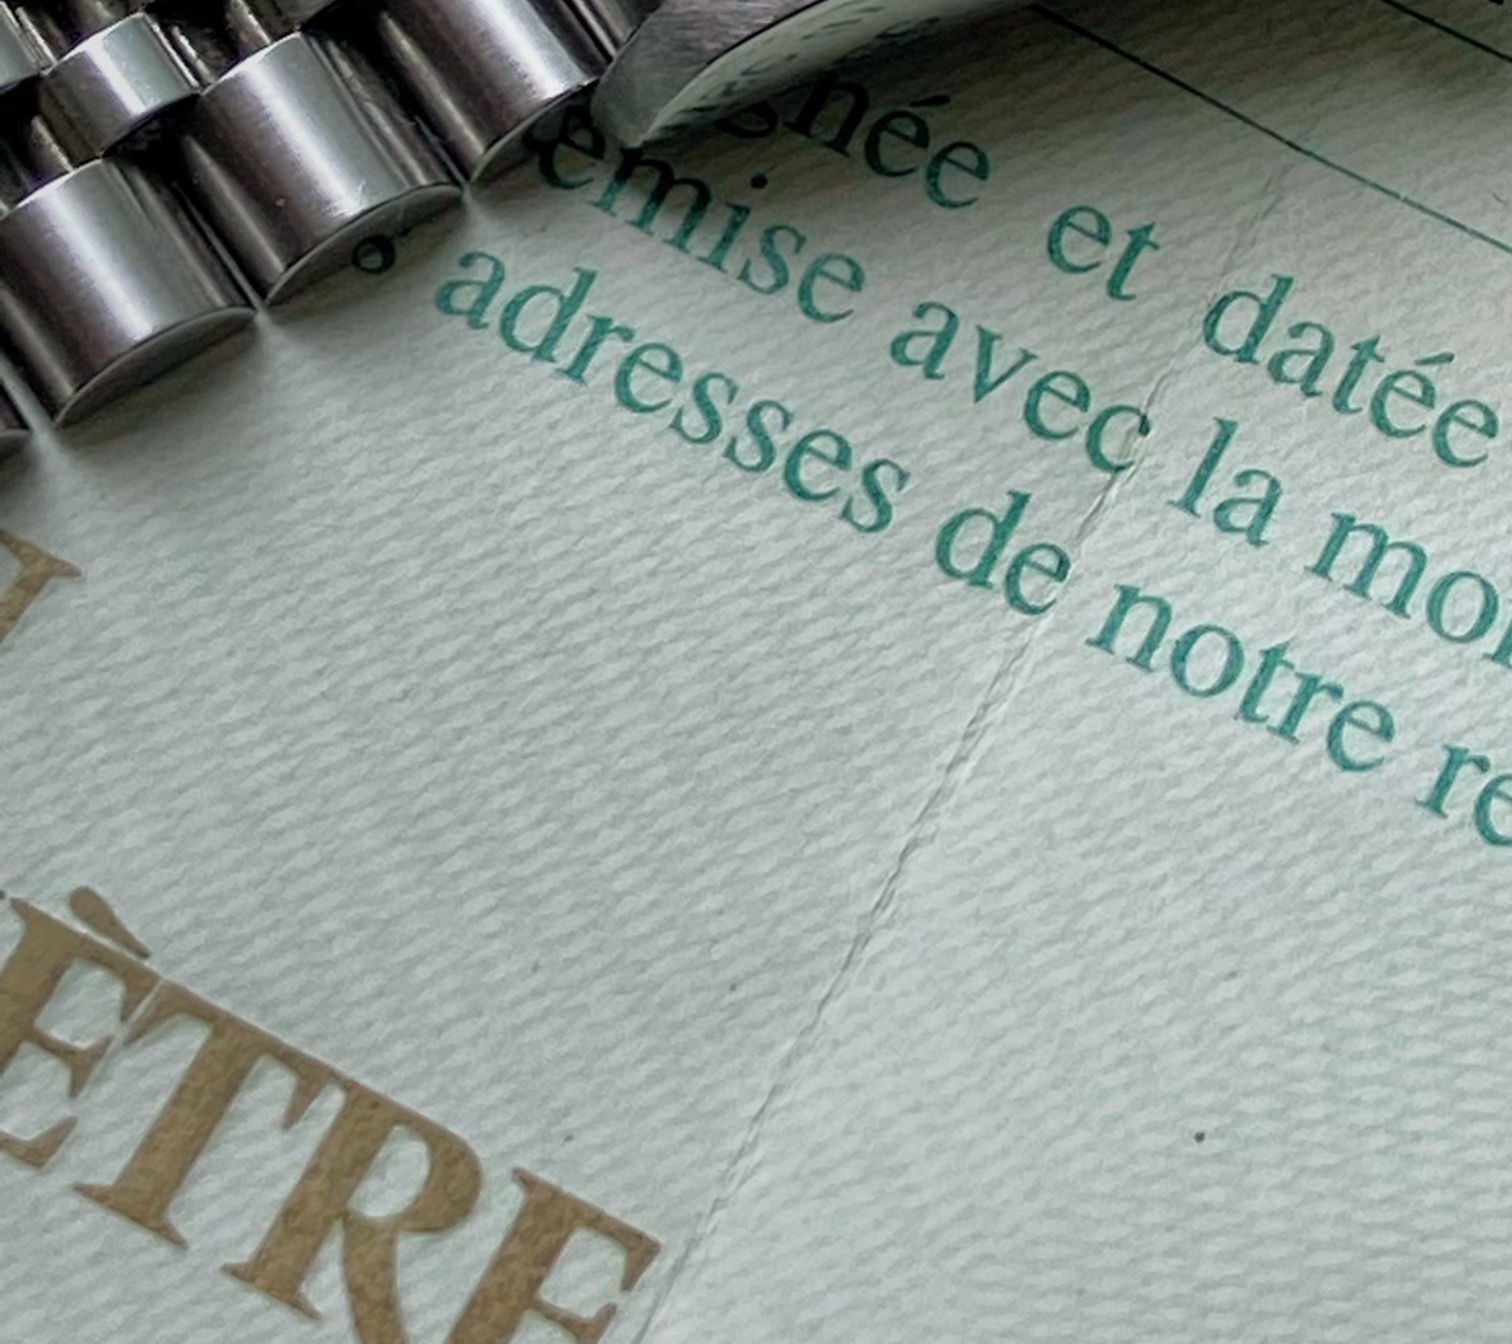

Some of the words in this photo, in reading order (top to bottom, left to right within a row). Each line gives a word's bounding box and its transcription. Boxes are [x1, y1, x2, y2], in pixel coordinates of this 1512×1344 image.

[889, 301, 1151, 473] avec
[1169, 417, 1283, 547] la
[1047, 206, 1160, 301] et
[1203, 274, 1499, 468] datée
[433, 250, 910, 533] adresses
[935, 490, 1071, 615] de
[1086, 583, 1395, 772] notre
